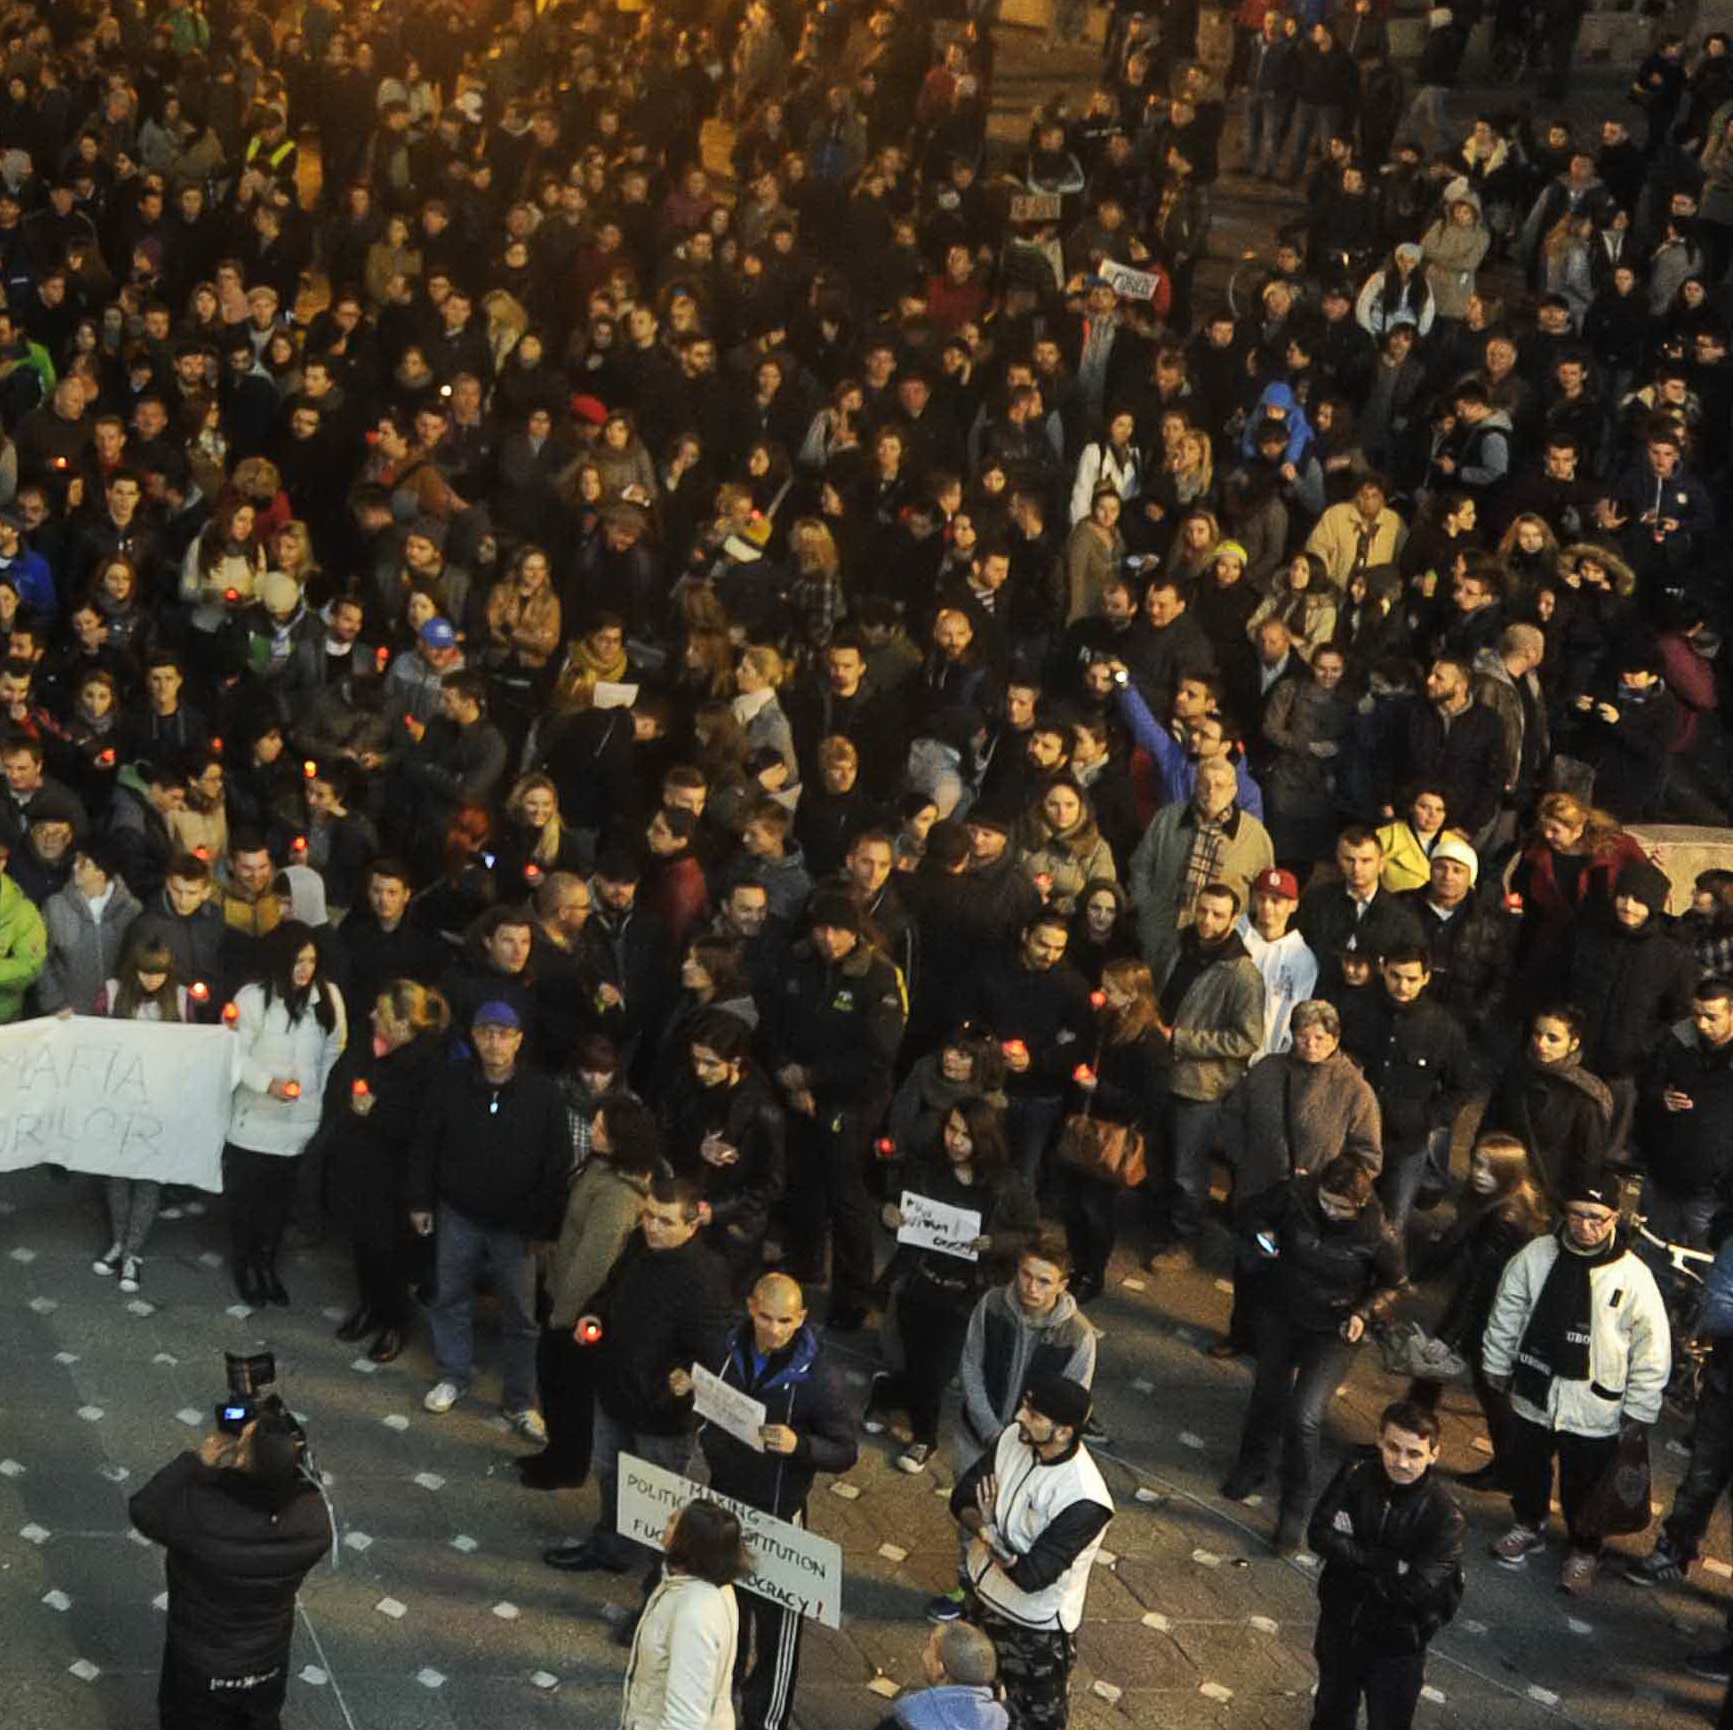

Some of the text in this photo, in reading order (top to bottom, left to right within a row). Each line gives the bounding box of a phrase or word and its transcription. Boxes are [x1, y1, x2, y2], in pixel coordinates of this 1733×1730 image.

[626, 1473, 826, 1580] POLITIC STITUTION
[633, 1517, 664, 1543] FUC
[747, 1574, 810, 1615] OCRACY
